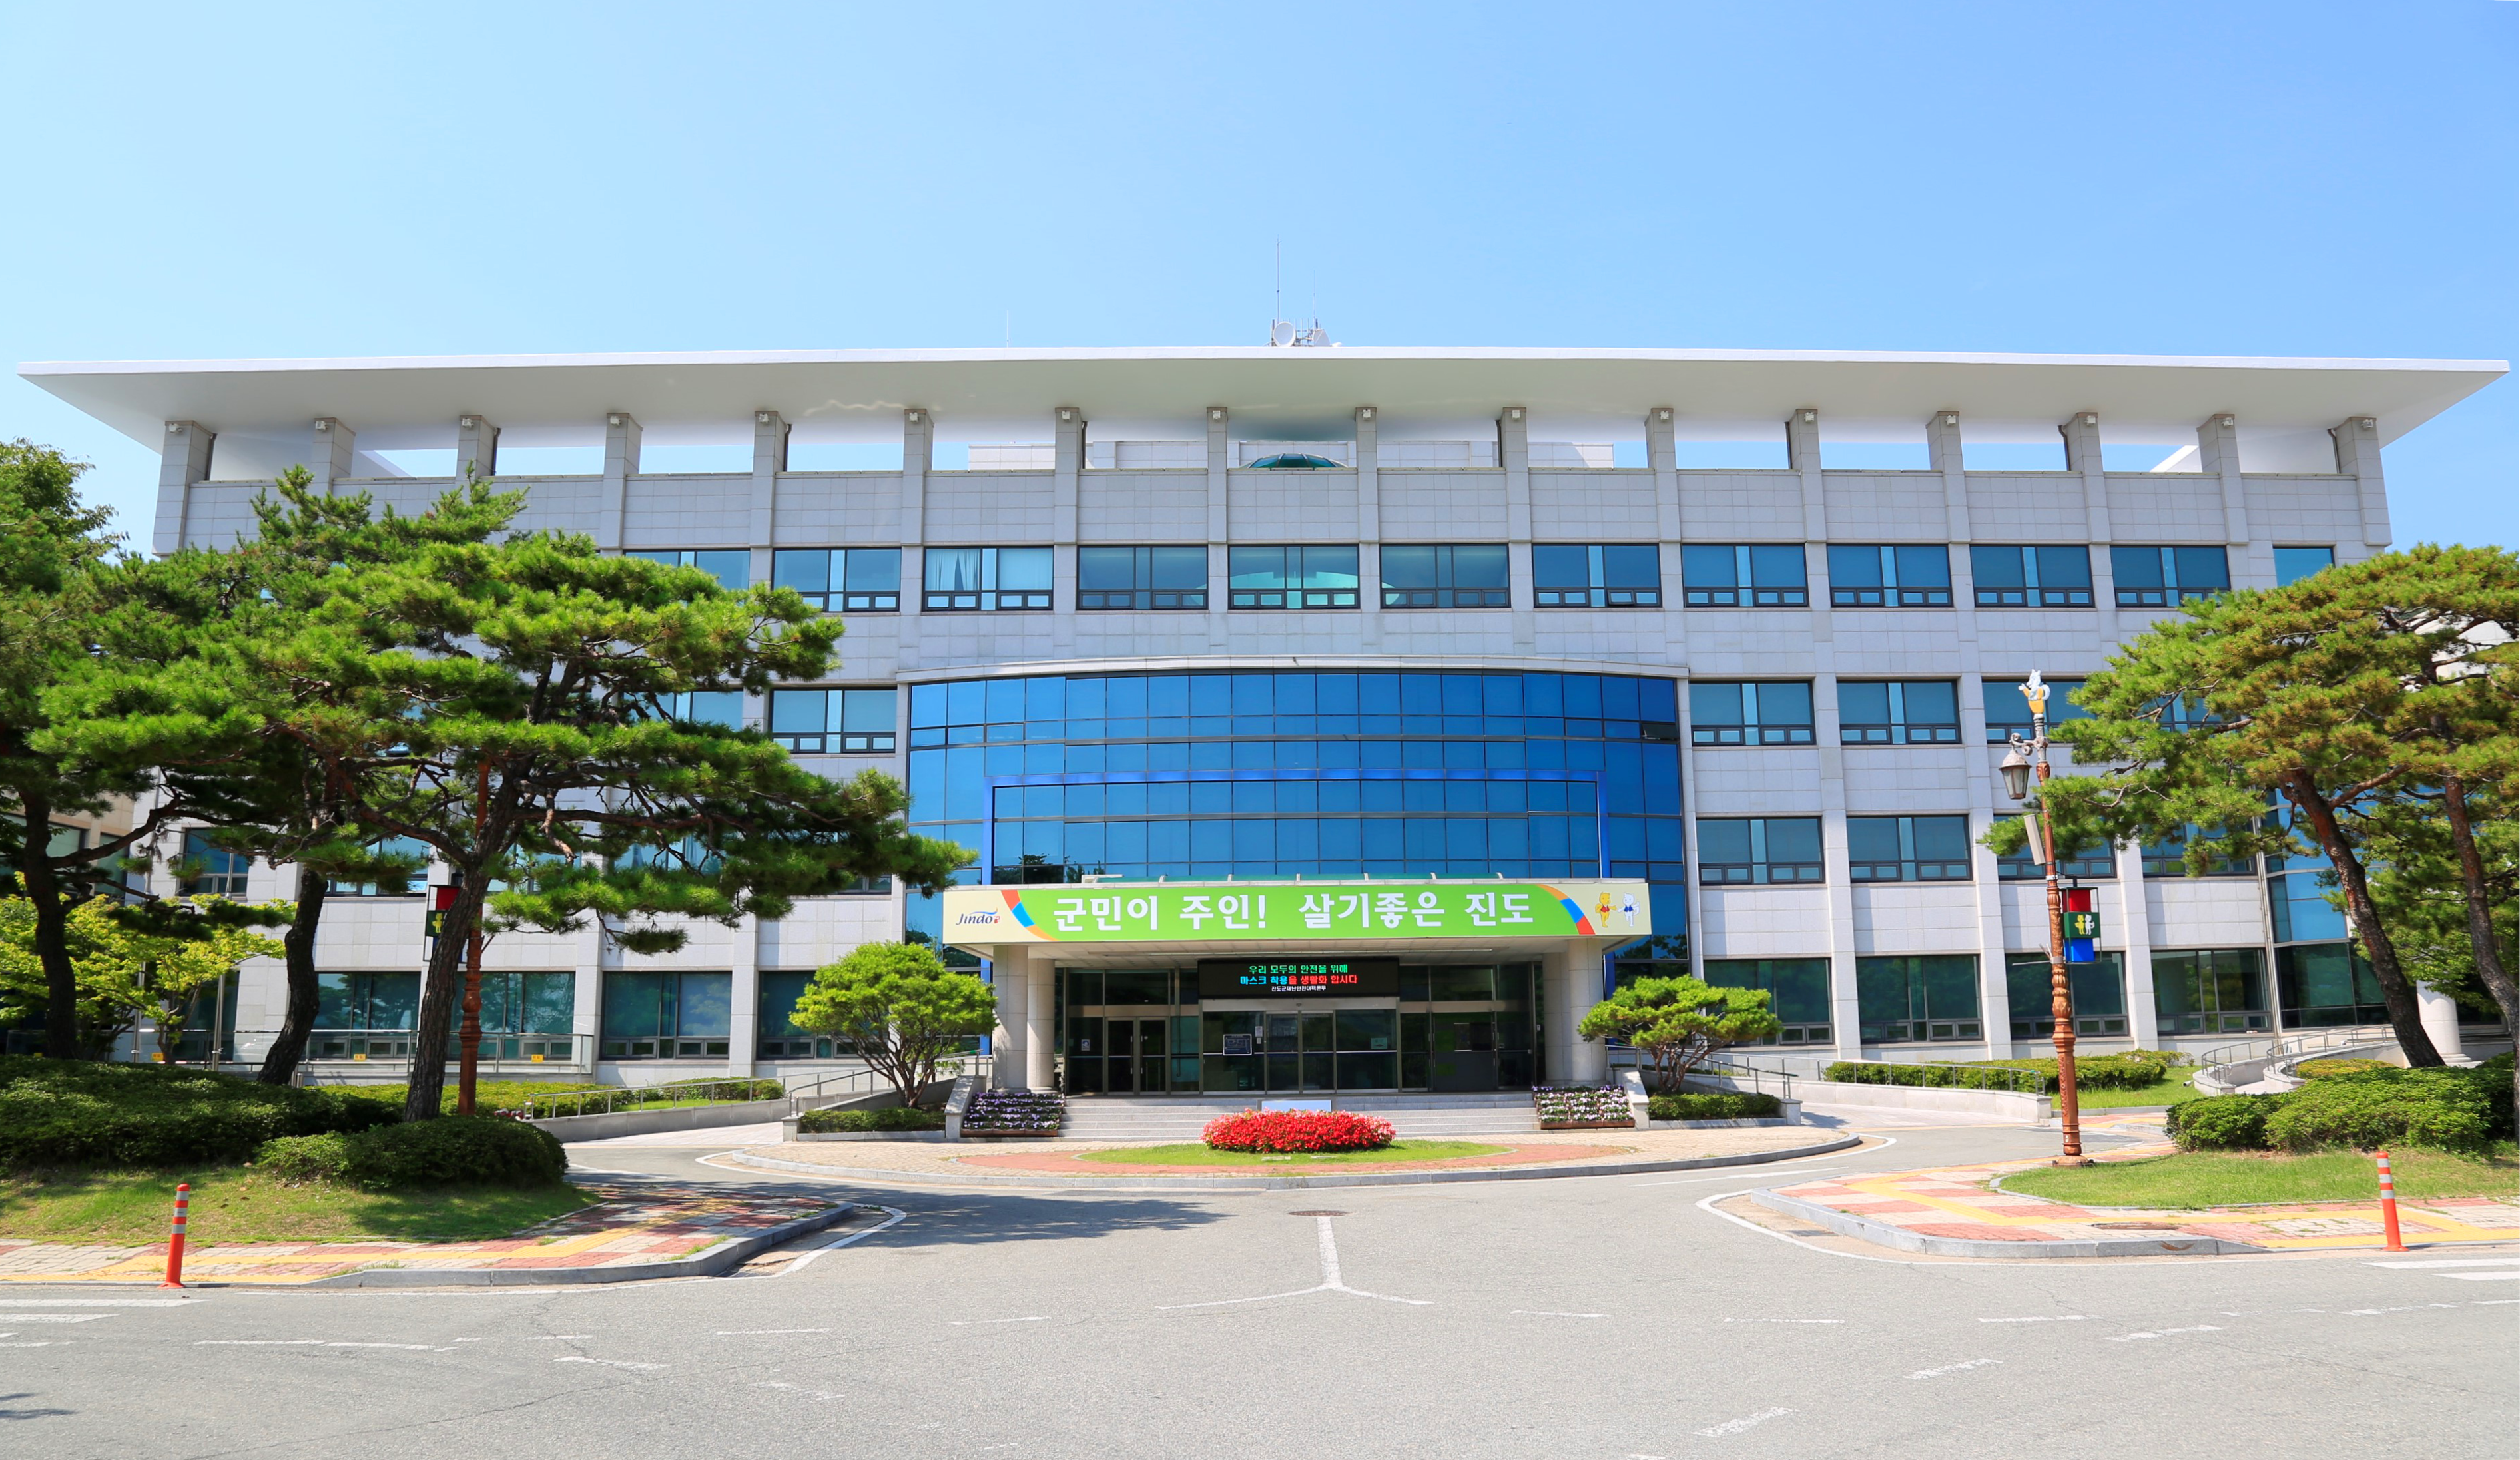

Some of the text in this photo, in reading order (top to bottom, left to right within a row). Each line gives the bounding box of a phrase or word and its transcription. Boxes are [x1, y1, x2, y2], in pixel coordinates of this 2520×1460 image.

[1053, 891, 1534, 932] 군민이 주인! 살기좋은 진도
[955, 913, 994, 925] Jindo
[1249, 964, 1348, 974] 우리 모두의 안전을 위해
[1240, 975, 1358, 985] 마스크 착용을 생활화 합시다
